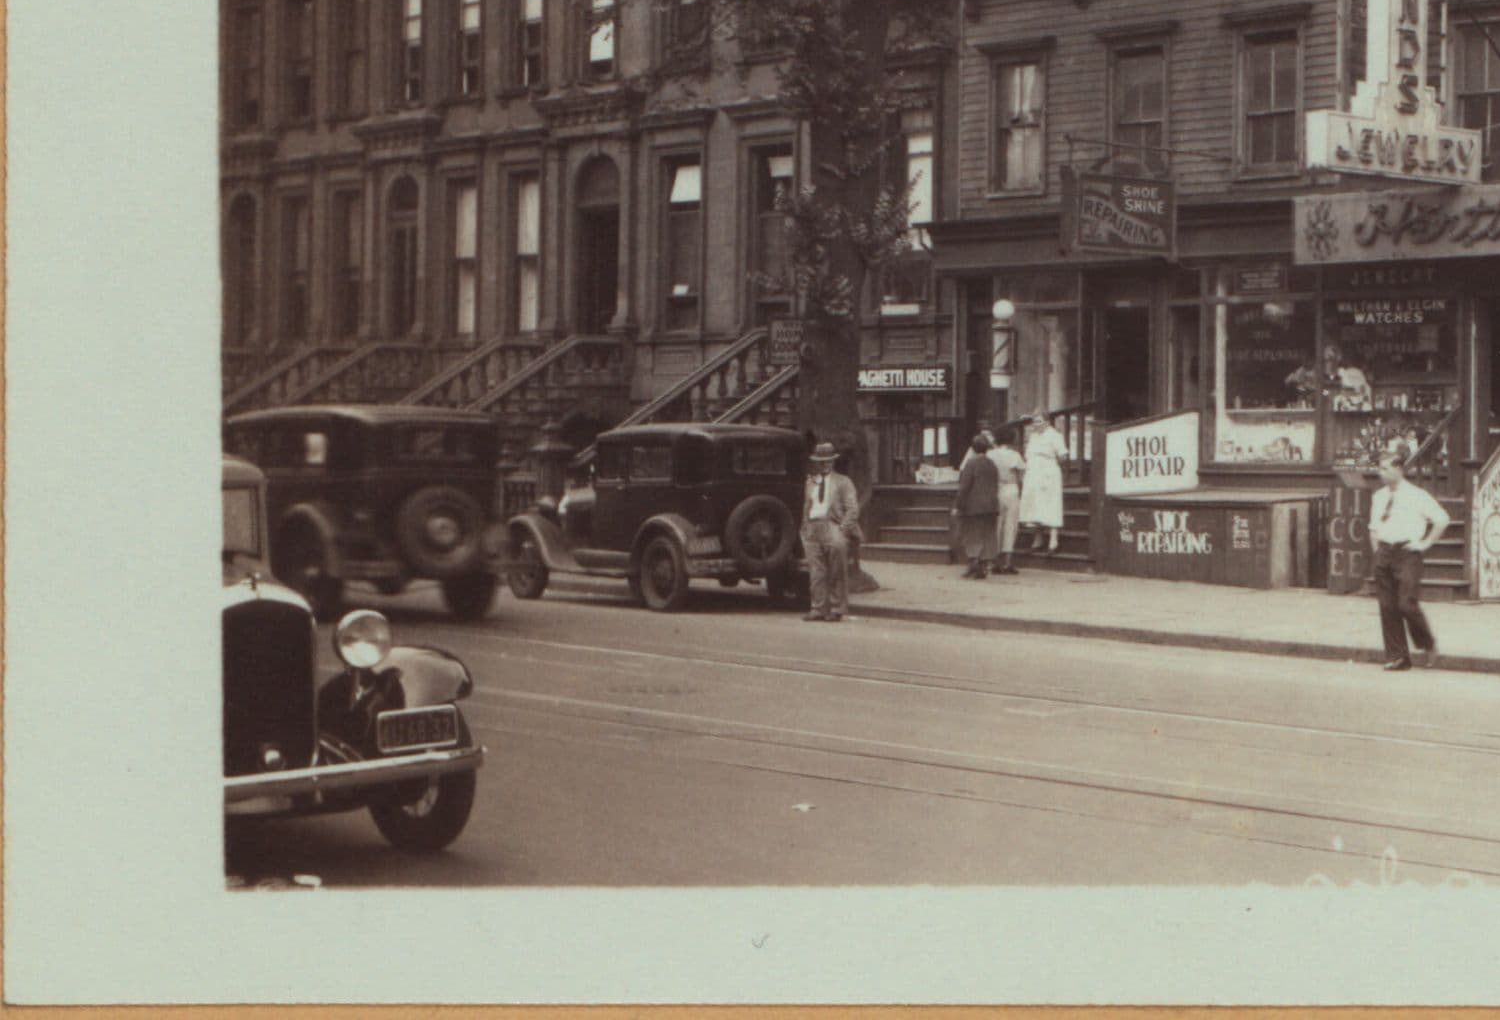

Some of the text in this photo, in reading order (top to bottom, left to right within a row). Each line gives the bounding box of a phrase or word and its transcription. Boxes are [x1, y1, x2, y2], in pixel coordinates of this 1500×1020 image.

[1336, 122, 1474, 175] JEWELRY
[1121, 184, 1159, 200] SHOE
[1123, 199, 1165, 215] SHINE
[1082, 199, 1162, 245] REPAIRING
[1354, 311, 1424, 324] WATCHES
[857, 367, 947, 388] AGHETTI HOUSE
[1126, 435, 1169, 458] SHOE
[1121, 456, 1186, 479] REPAIR
[1153, 510, 1191, 532] SHOE
[1137, 530, 1214, 555] REPAIRING
